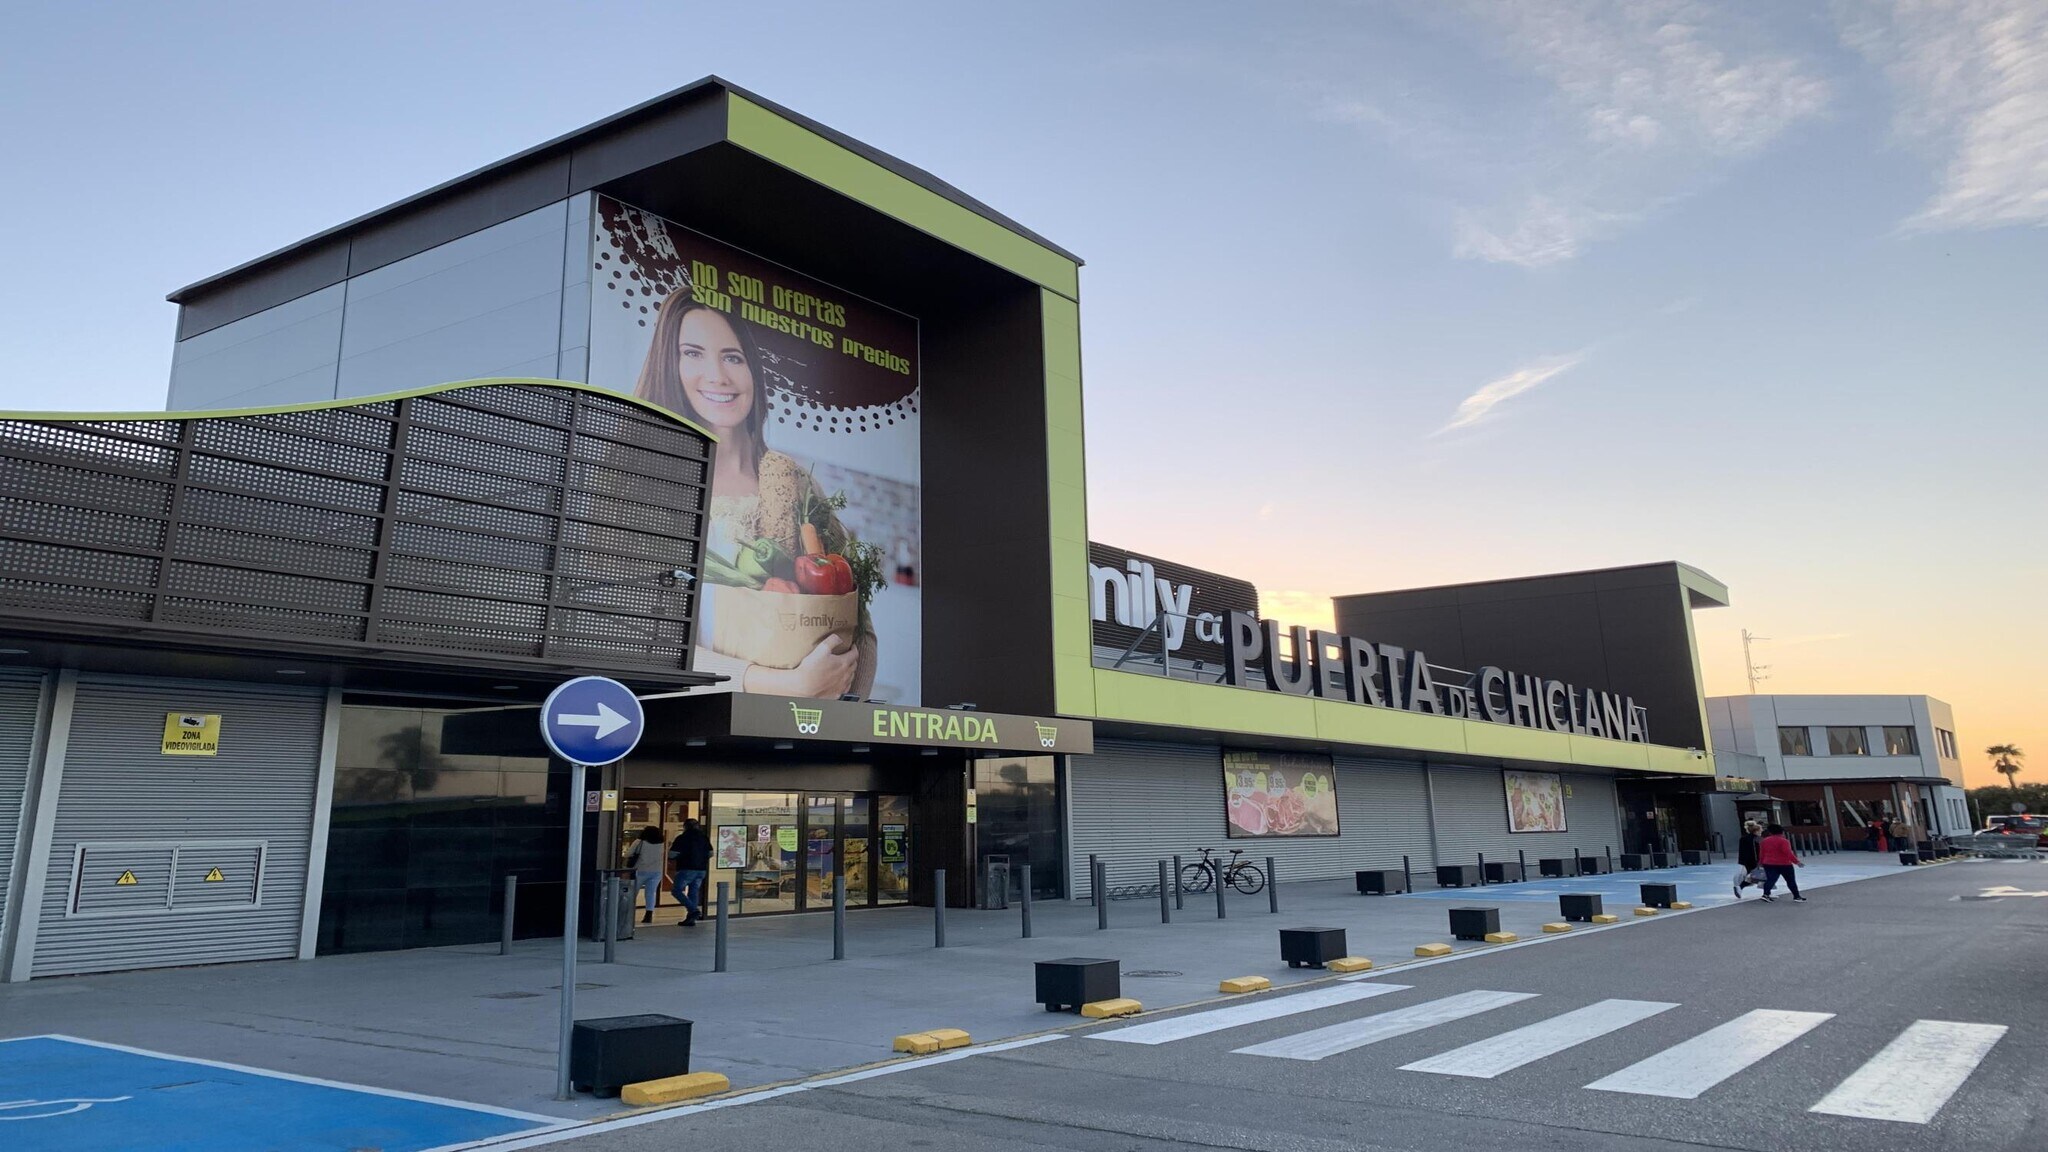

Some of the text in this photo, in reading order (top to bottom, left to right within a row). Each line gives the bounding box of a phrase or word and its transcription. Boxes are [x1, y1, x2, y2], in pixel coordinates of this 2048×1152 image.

[692, 259, 846, 328] no son ofertas
[691, 285, 910, 375] son nuestros precios
[799, 613, 834, 630] family
[1223, 609, 1645, 744] PUERTA DE CHICLANA
[182, 730, 201, 740] ZONA
[872, 709, 998, 744] ENTRADA
[165, 741, 216, 751] VIDEOVIGILADA
